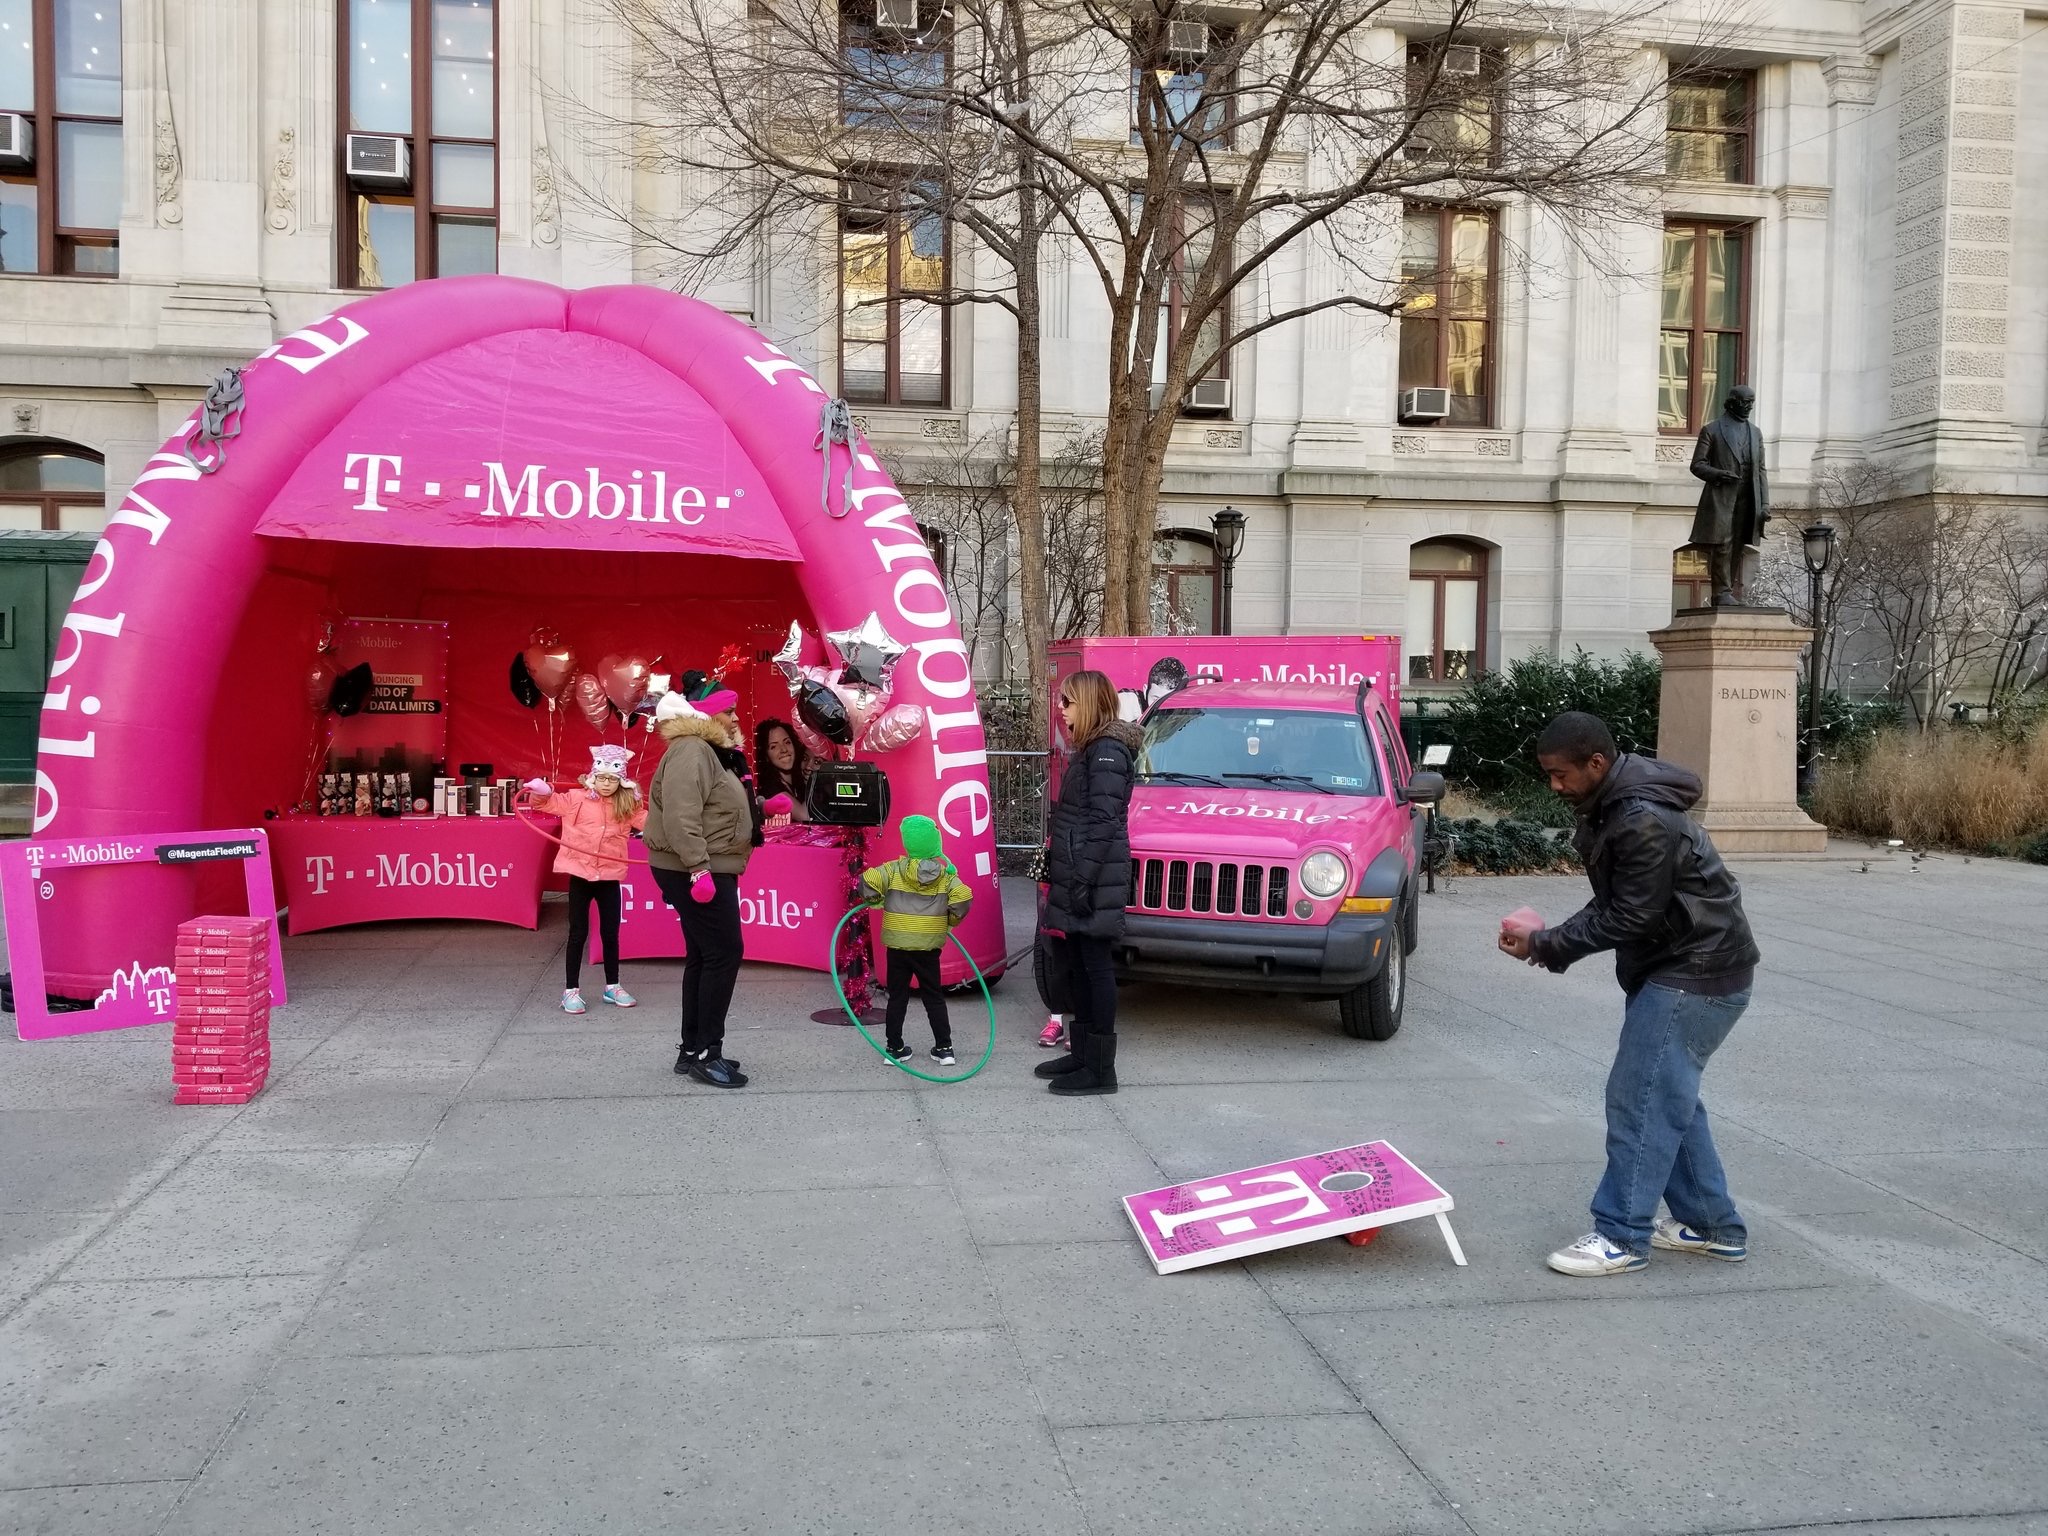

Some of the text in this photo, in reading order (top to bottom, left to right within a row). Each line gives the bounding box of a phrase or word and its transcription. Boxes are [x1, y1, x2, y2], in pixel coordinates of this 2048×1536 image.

[373, 675, 415, 685] OUNCING
[372, 687, 408, 698] ND OF
[1721, 687, 1787, 700] BALDWIN
[370, 701, 436, 712] DATA LIMITS
[167, 845, 255, 860] @MagentaFleetPHL
[737, 888, 801, 929] bile
[147, 988, 171, 1015] T
